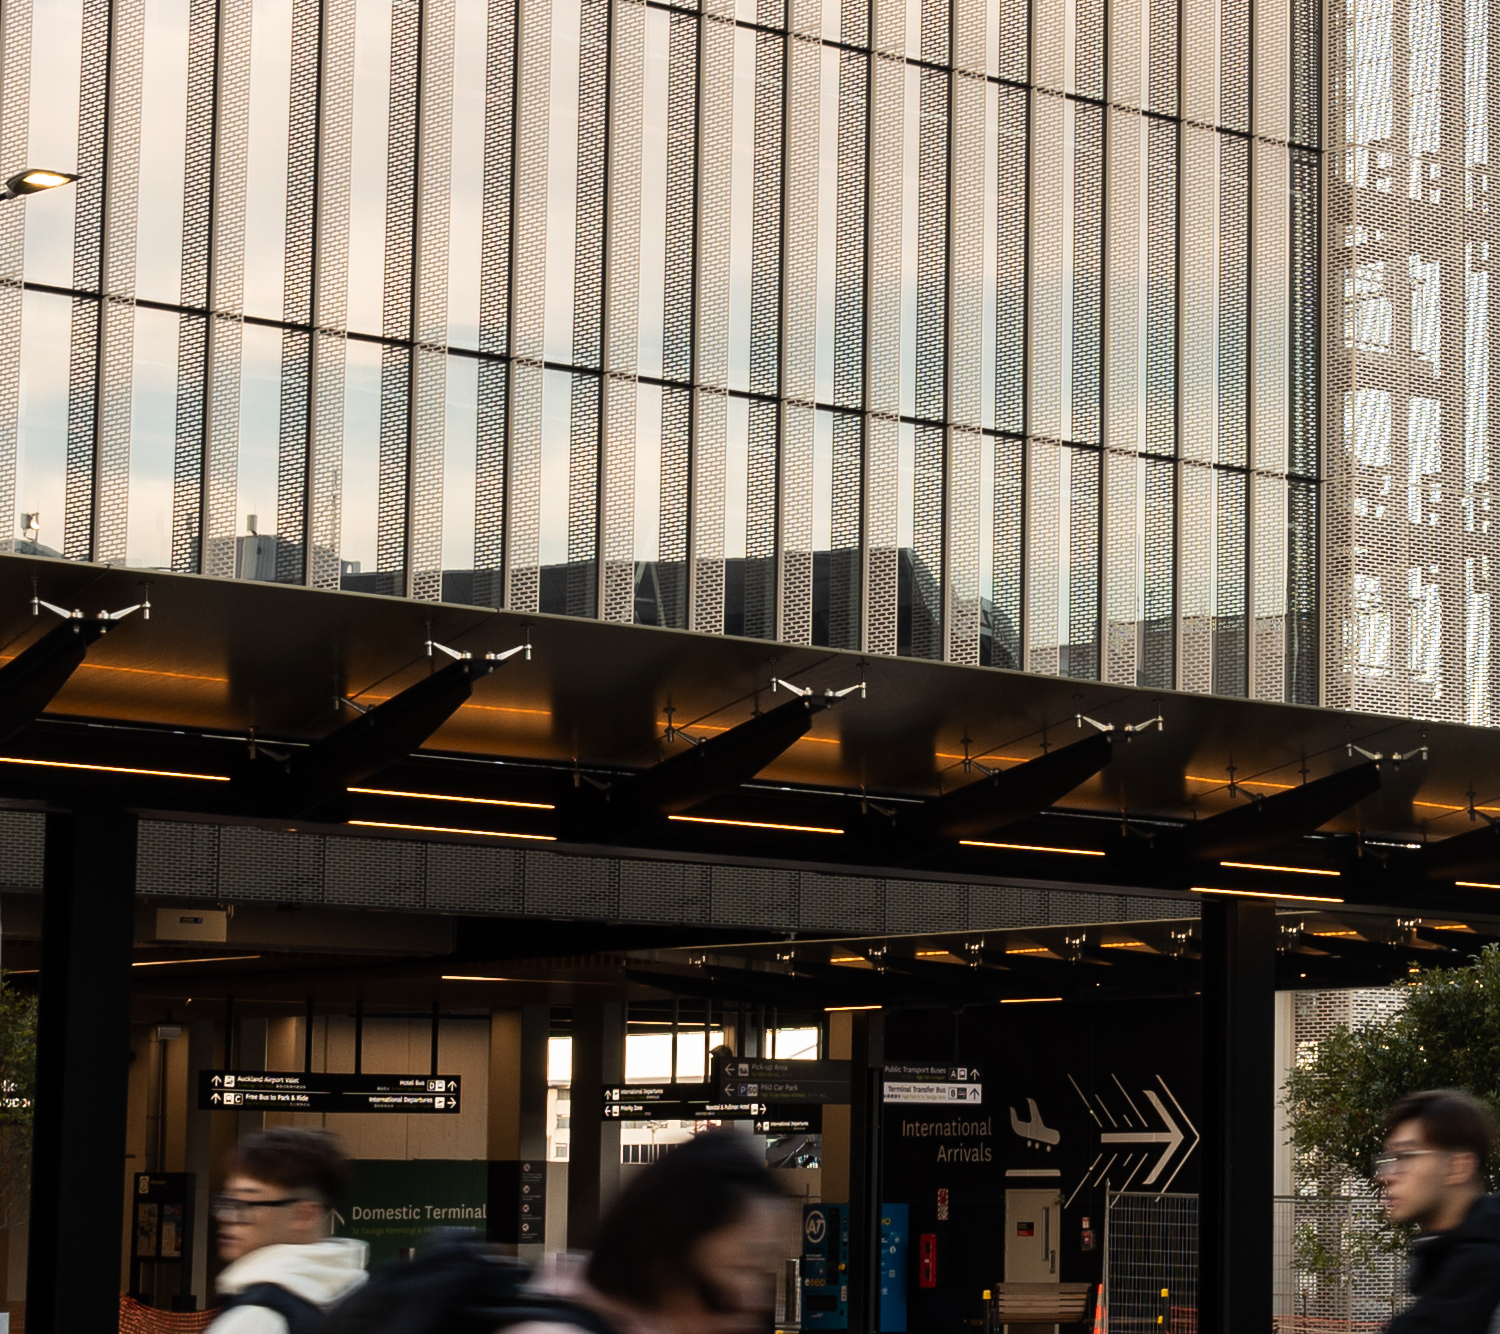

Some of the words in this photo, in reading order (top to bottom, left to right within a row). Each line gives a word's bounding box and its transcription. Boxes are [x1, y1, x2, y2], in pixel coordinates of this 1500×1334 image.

[902, 1116, 992, 1137] International
[937, 1142, 992, 1162] Arrivals
[352, 1204, 420, 1220] Domestic
[425, 1203, 487, 1219] Terminal
